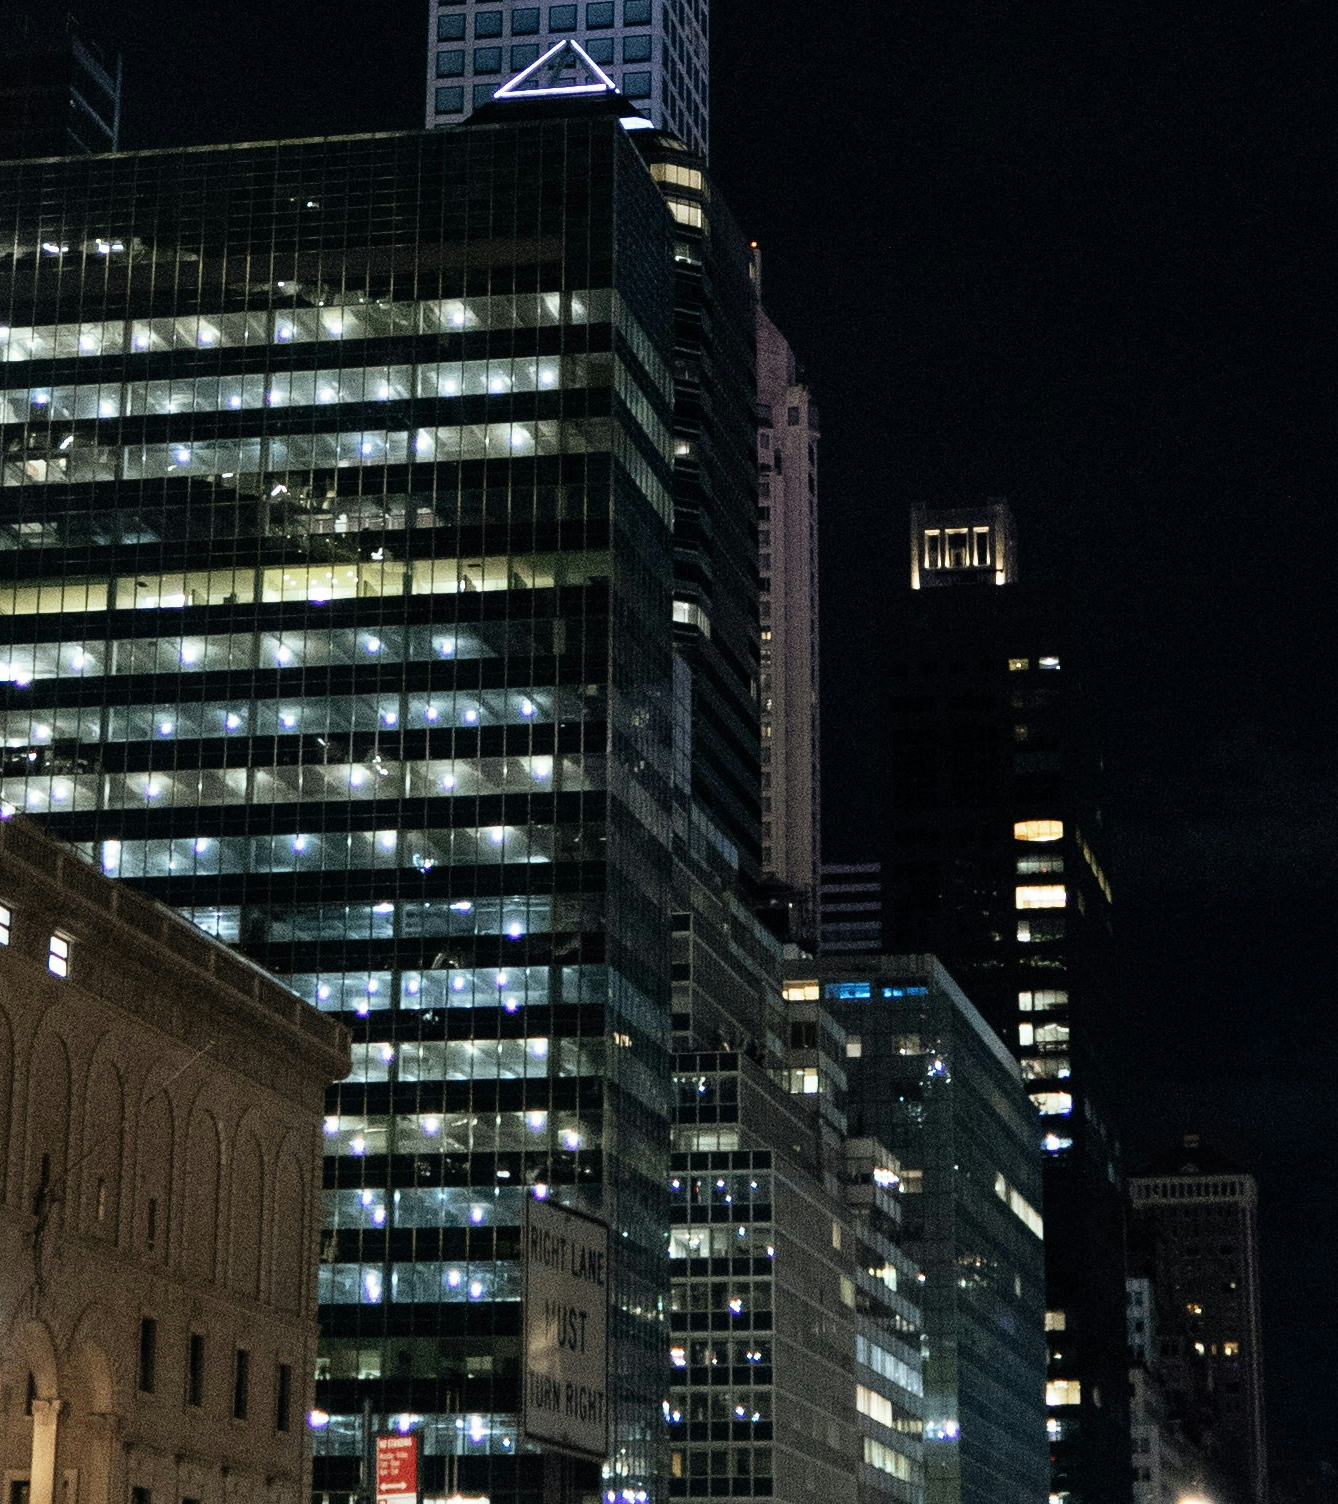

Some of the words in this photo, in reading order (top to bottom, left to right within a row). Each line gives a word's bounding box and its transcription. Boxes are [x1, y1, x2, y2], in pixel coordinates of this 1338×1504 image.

[530, 1224, 566, 1272] RIGHT
[571, 1243, 604, 1287] LANE
[565, 1380, 604, 1425] RIGHT
